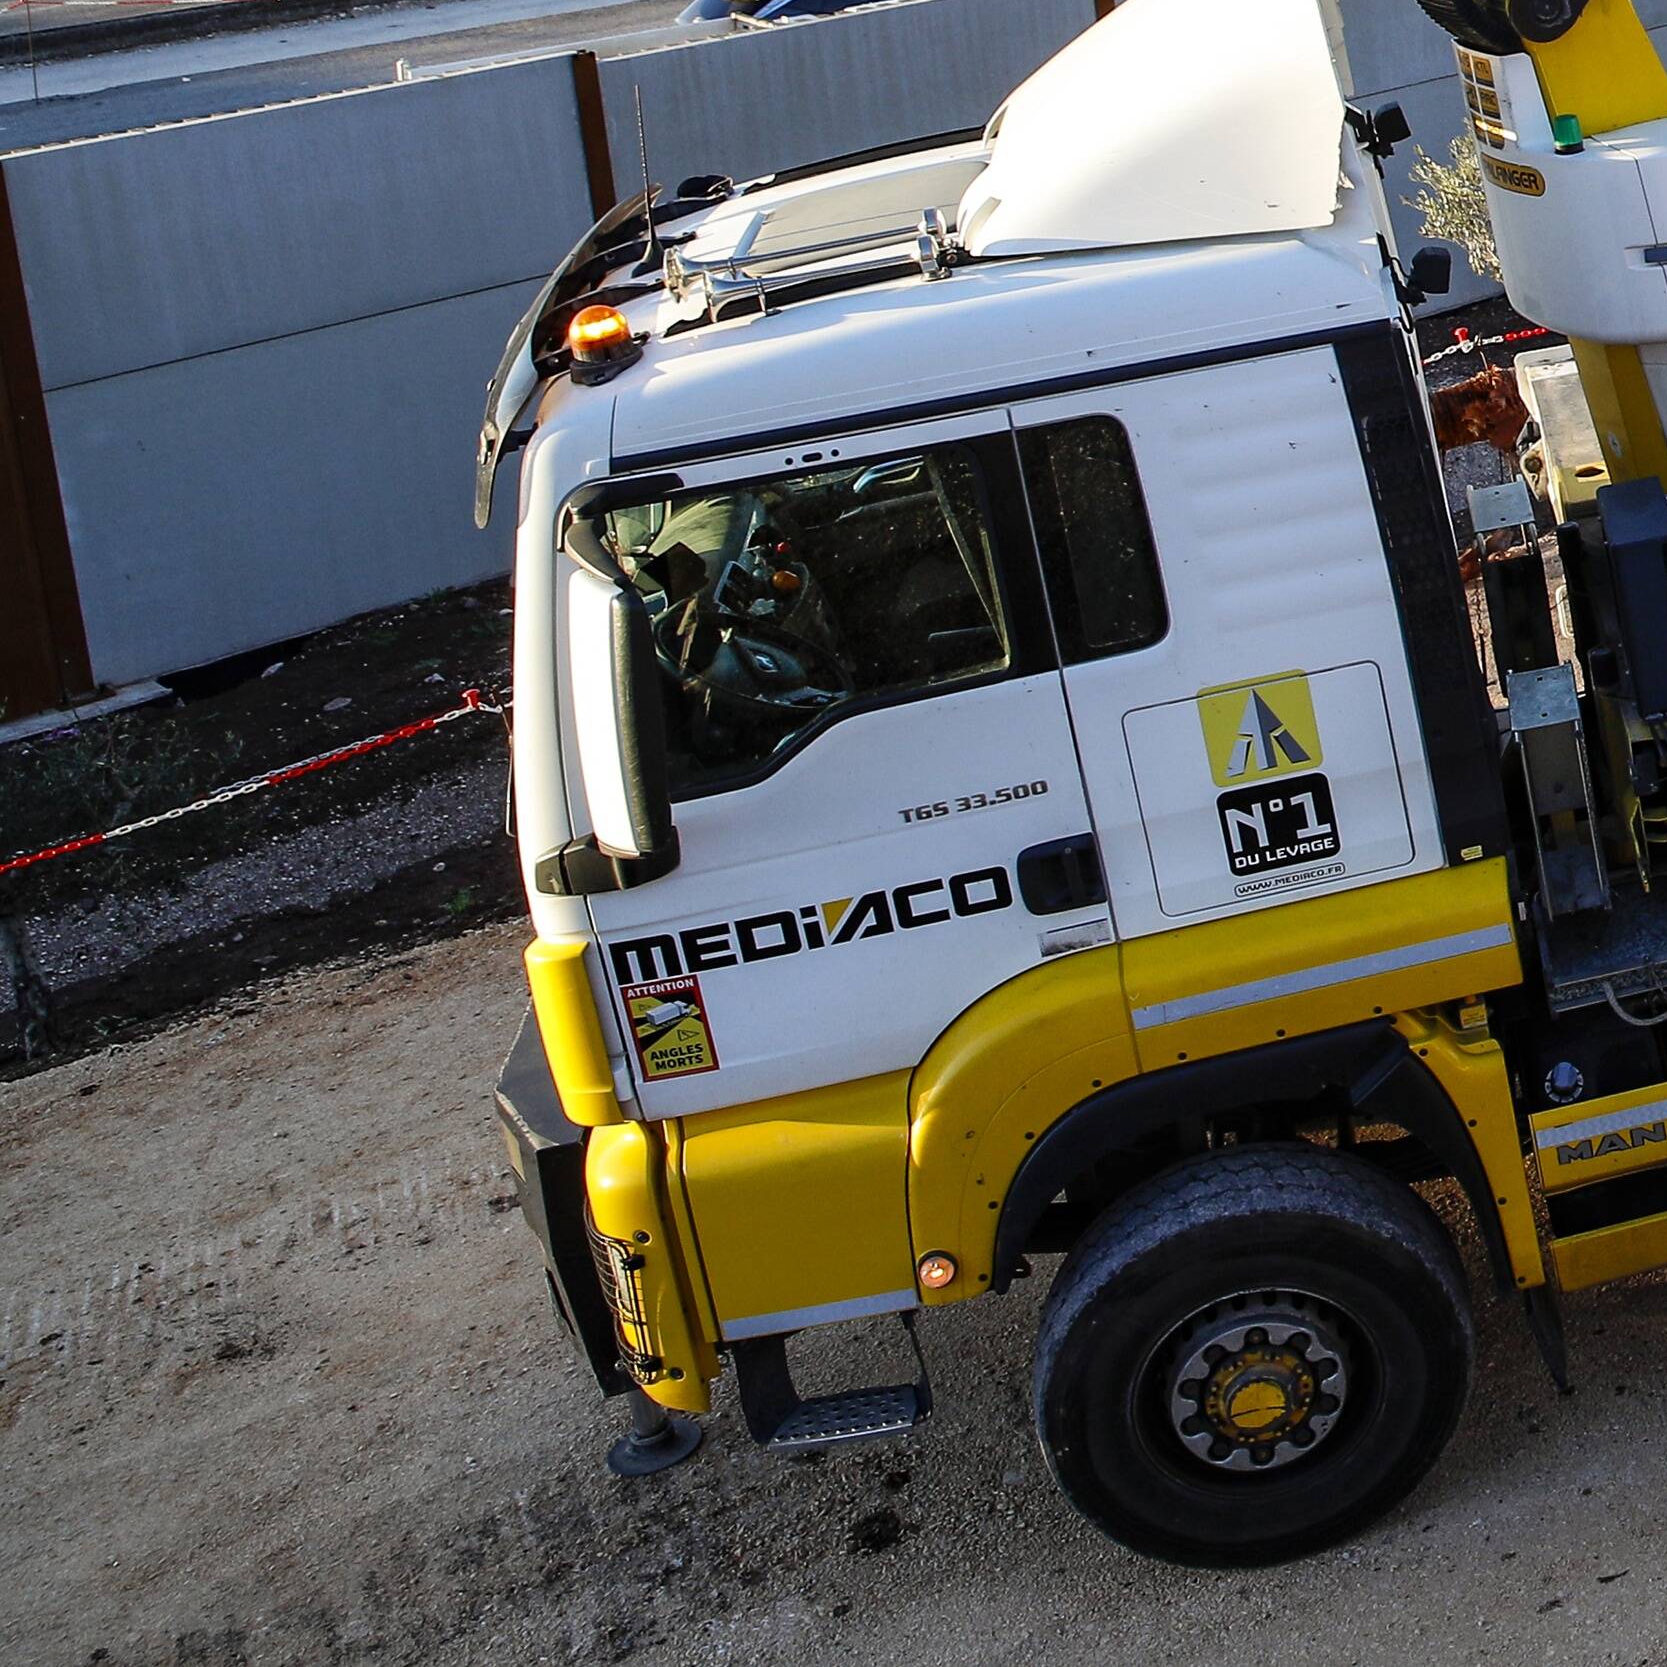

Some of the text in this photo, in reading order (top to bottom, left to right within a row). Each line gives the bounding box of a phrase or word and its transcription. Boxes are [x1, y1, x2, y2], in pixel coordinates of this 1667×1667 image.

[898, 780, 1049, 823] TGS 33.500
[1234, 837, 1335, 869] DU LEVAGE
[627, 978, 694, 998] ATTENTION
[650, 1043, 704, 1061] ANGLES
[655, 1054, 704, 1071] MORTS
[1556, 1121, 1667, 1165] MAN
